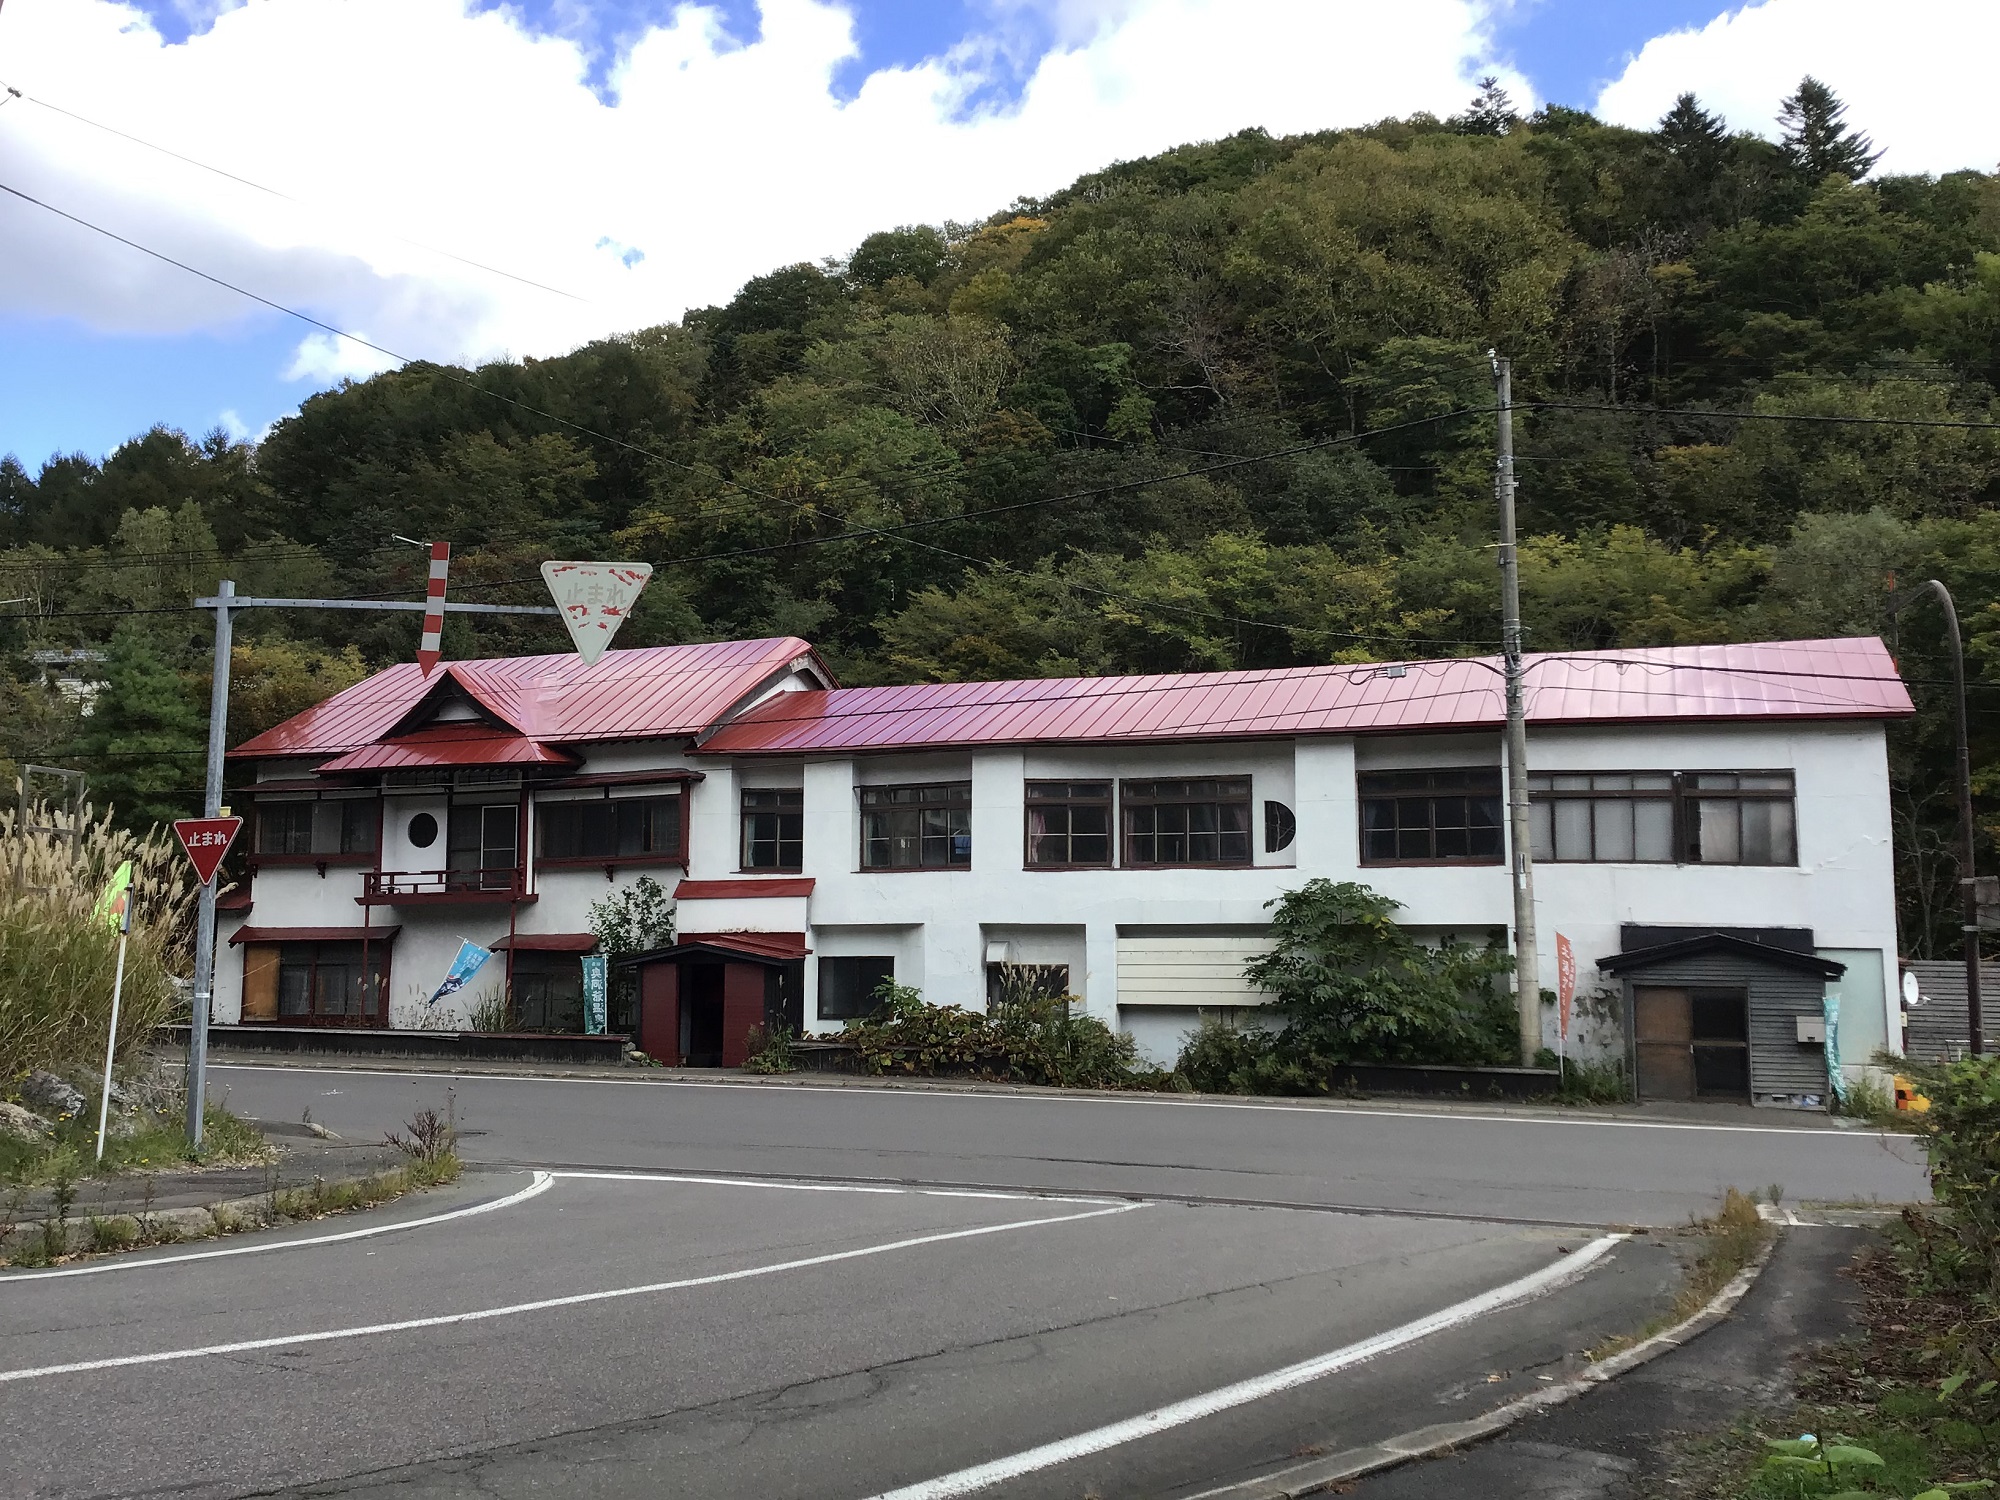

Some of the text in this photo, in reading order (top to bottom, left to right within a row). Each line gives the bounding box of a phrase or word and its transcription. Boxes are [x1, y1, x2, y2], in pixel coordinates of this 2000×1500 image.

[564, 583, 626, 605] 止まれ
[187, 831, 227, 847] 止まれ
